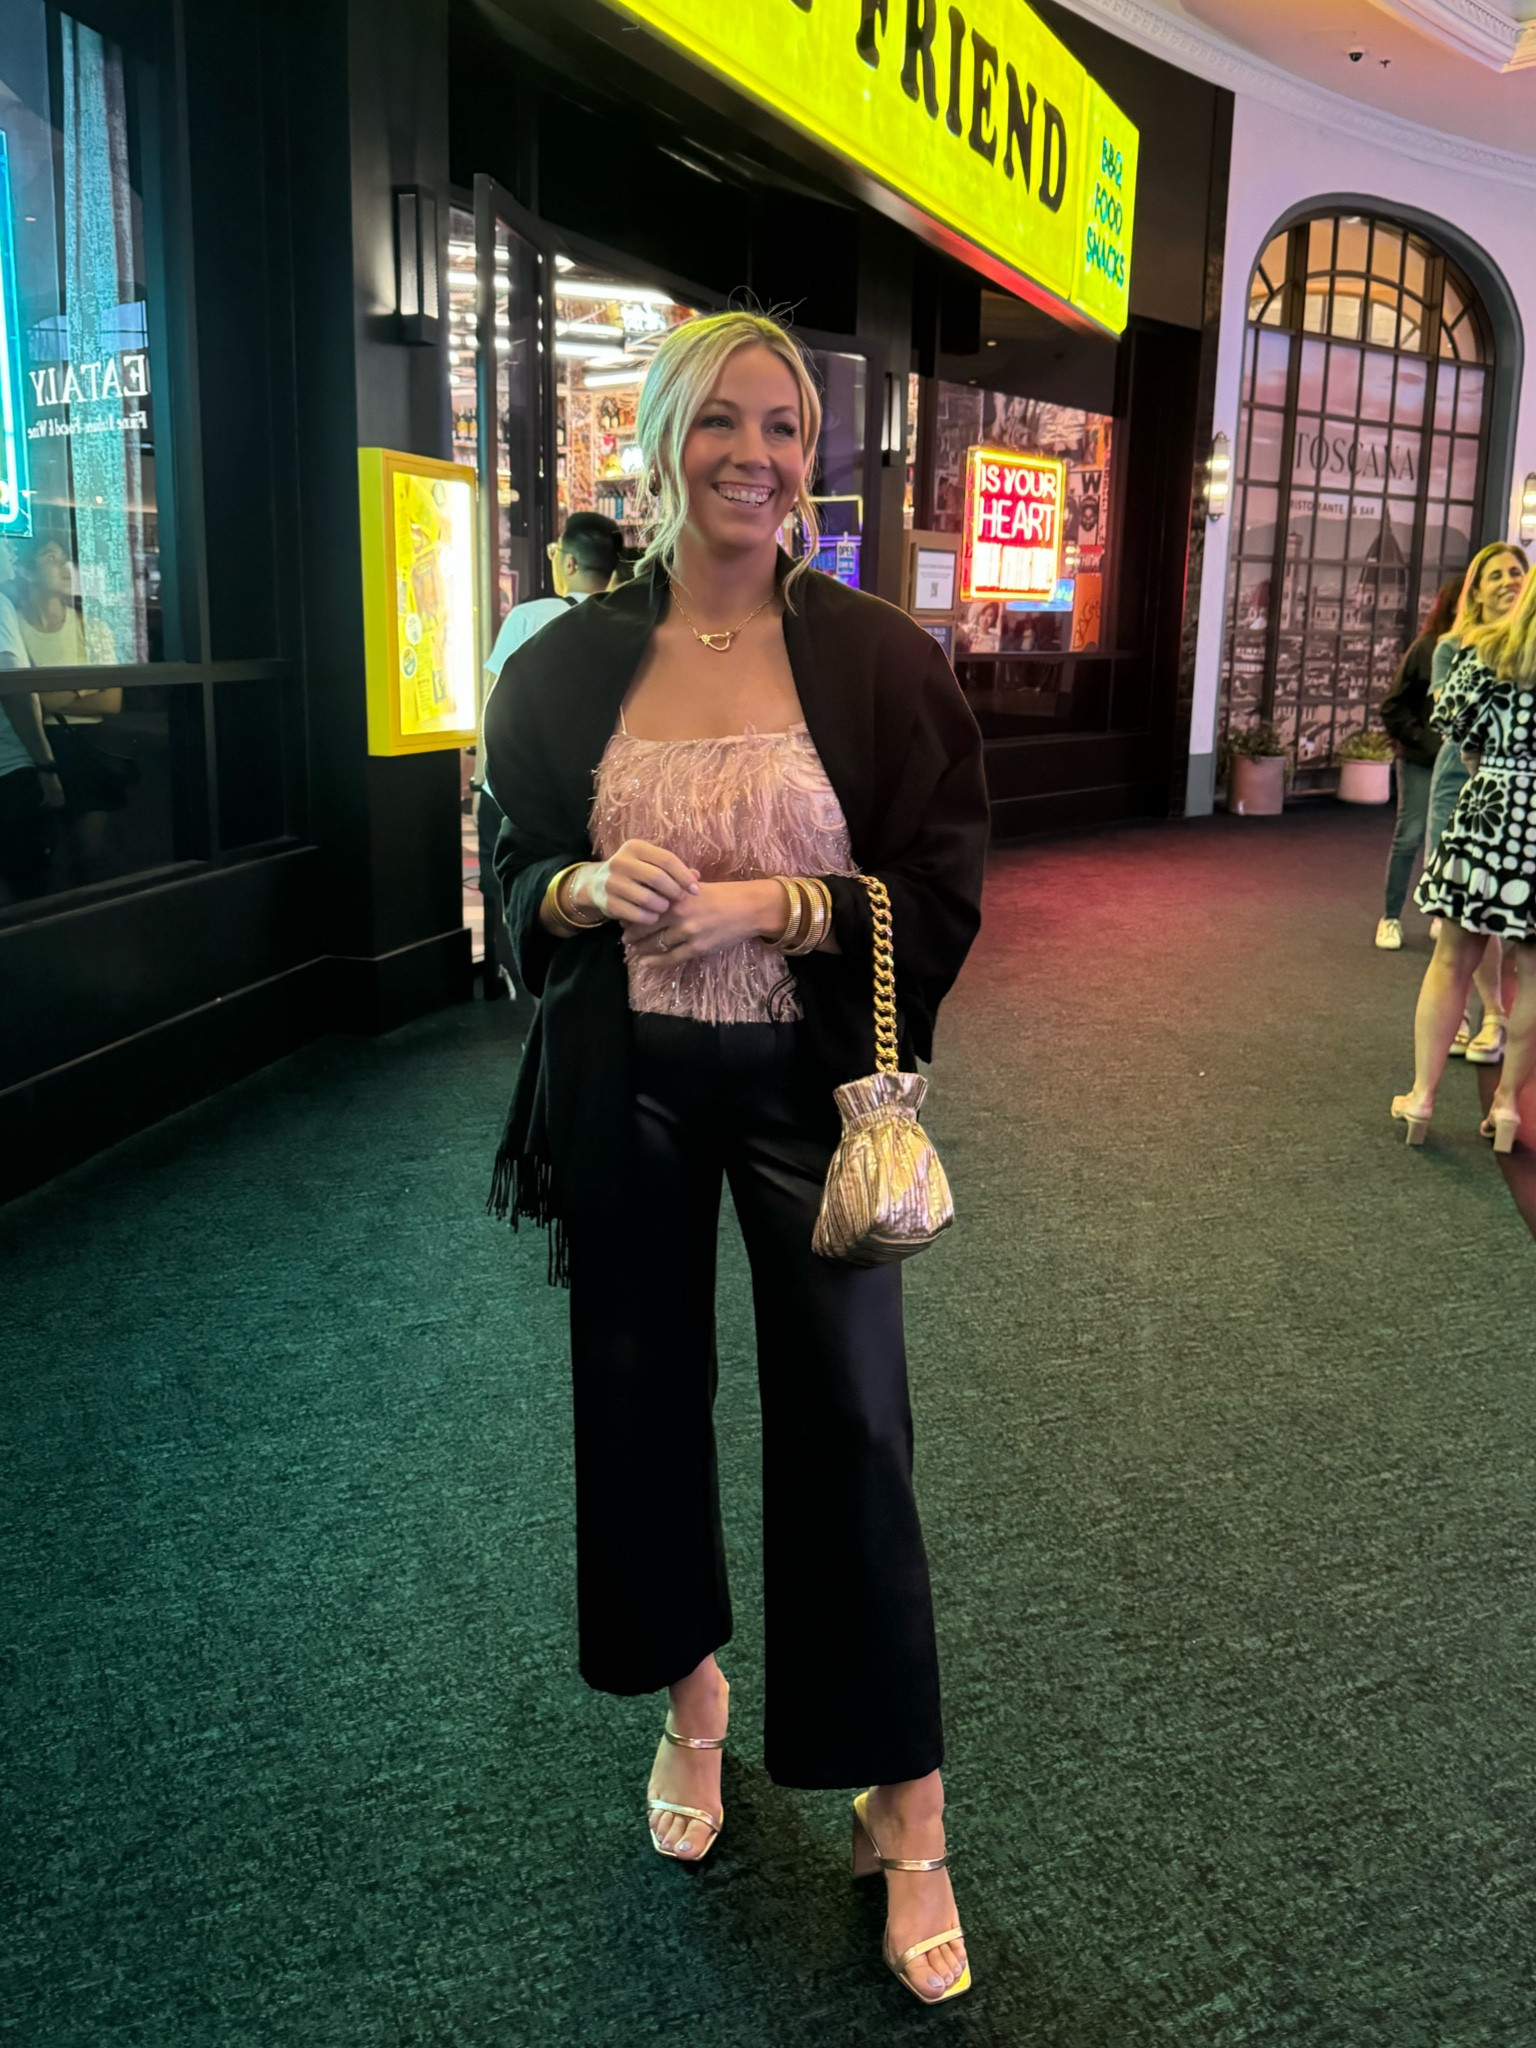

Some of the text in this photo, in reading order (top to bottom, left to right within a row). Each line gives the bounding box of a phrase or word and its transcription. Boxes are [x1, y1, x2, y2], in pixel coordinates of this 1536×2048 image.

[1101, 136, 1123, 190] BBQ
[1094, 182, 1123, 235] FOOD
[1086, 226, 1125, 288] SNACKS
[980, 464, 1056, 498] IS YOUR
[1294, 432, 1416, 481] TOSCANA
[978, 497, 1056, 541] HEART
